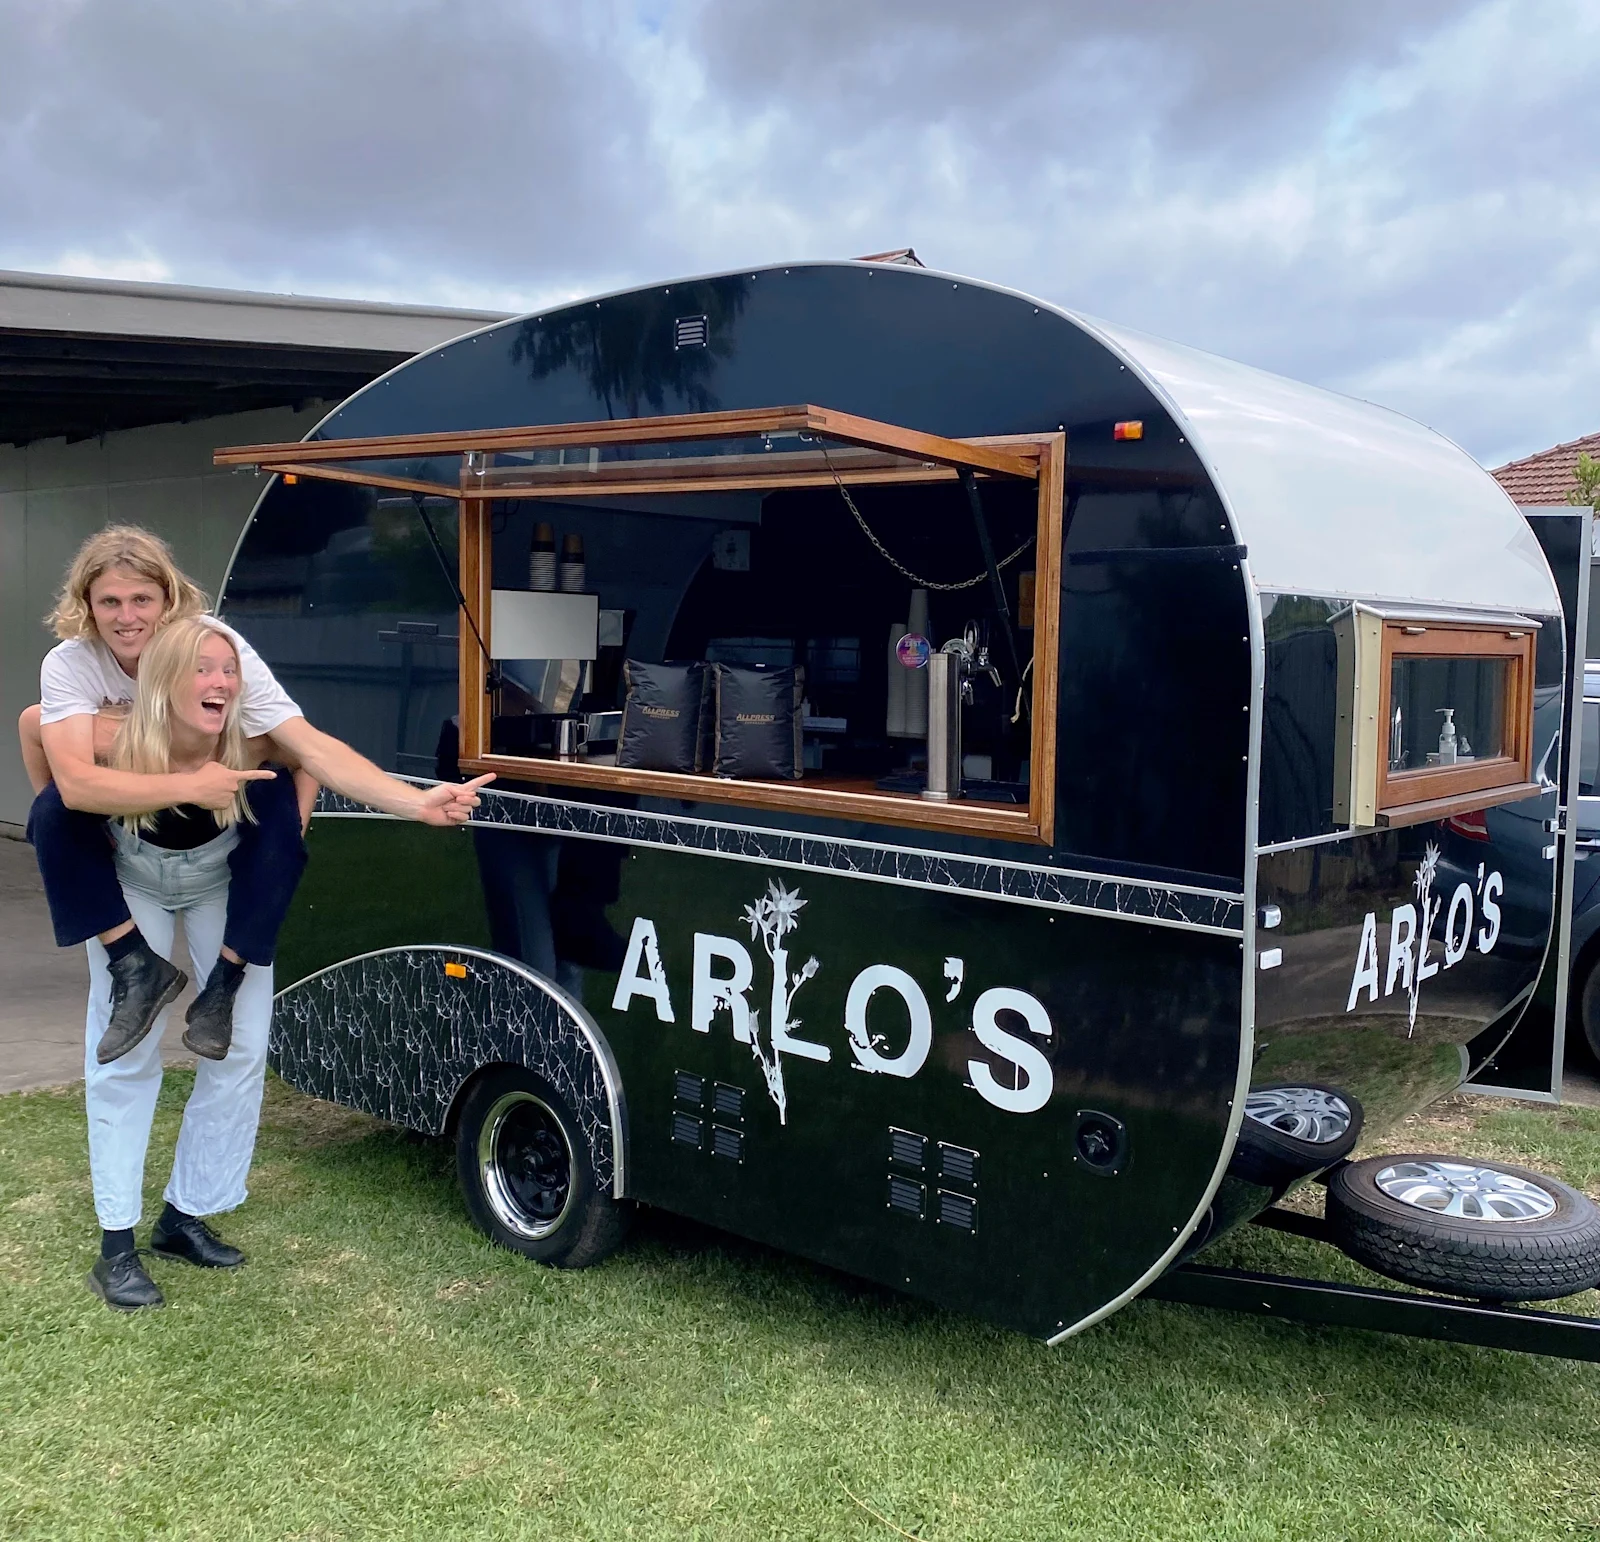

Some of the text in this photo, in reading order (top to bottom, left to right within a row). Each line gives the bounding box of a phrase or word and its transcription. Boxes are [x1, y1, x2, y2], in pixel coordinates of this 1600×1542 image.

[642, 706, 680, 717] ALLPRESS
[736, 713, 775, 721] ALLPRESS
[1346, 862, 1503, 1012] ARLO'S
[612, 916, 1054, 1113] ARLO'S
